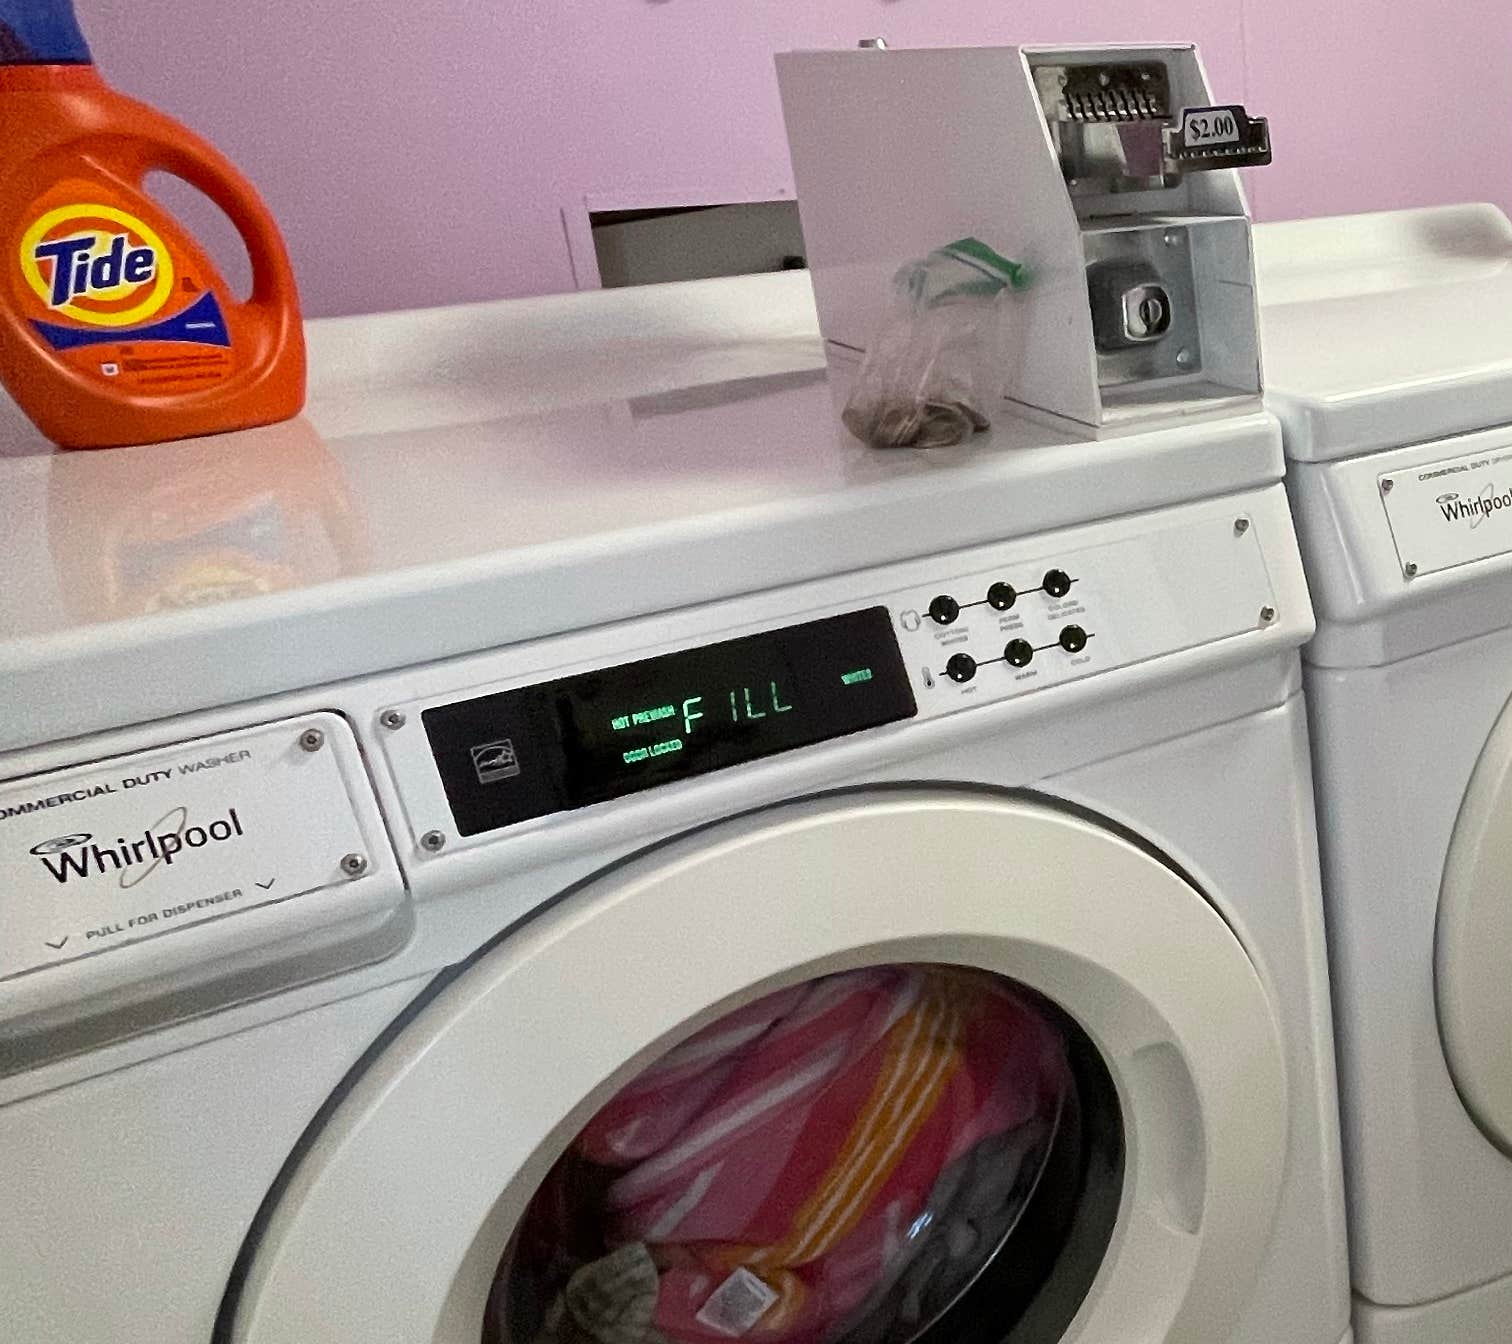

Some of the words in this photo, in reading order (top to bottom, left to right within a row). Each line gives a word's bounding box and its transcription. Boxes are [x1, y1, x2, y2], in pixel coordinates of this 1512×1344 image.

[1189, 116, 1234, 142] $2.00
[35, 236, 154, 307] Tide
[122, 768, 173, 789] DUTY
[178, 750, 251, 775] WASHER
[41, 808, 244, 884] Whirlpool
[86, 924, 124, 940] PULL
[128, 912, 159, 928] FOR
[162, 888, 243, 919] DISPENSER
